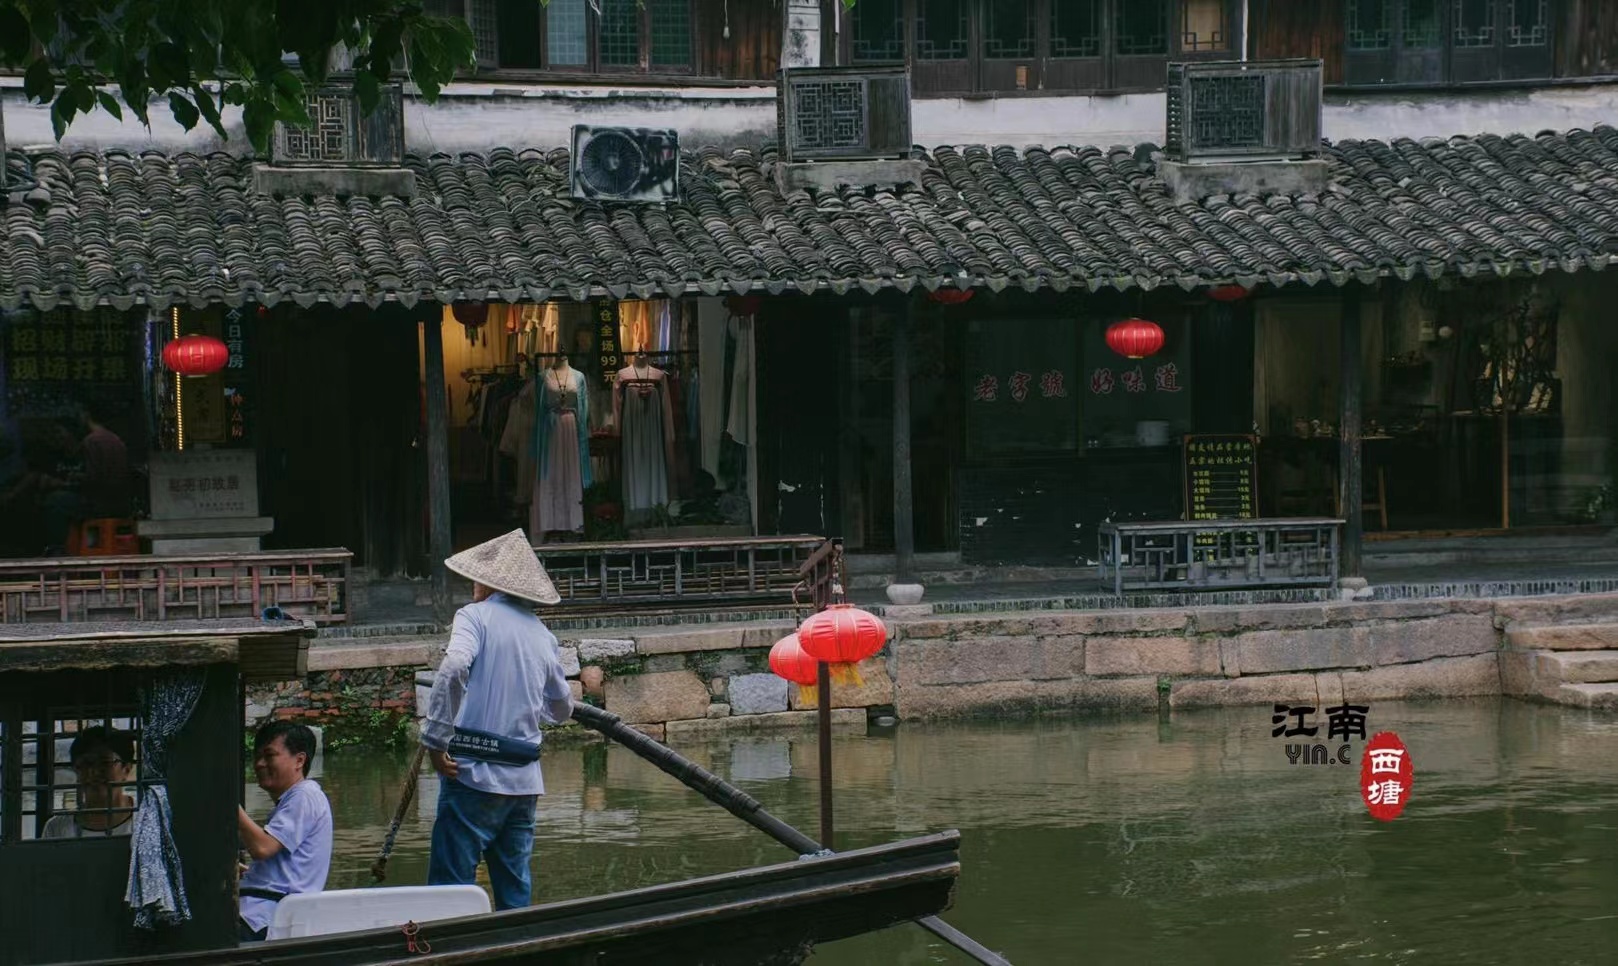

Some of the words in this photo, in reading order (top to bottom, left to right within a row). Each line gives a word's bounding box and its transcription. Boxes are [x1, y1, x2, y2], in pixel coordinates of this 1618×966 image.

[226, 308, 244, 369] 今日有房
[1090, 361, 1183, 394] 好味道
